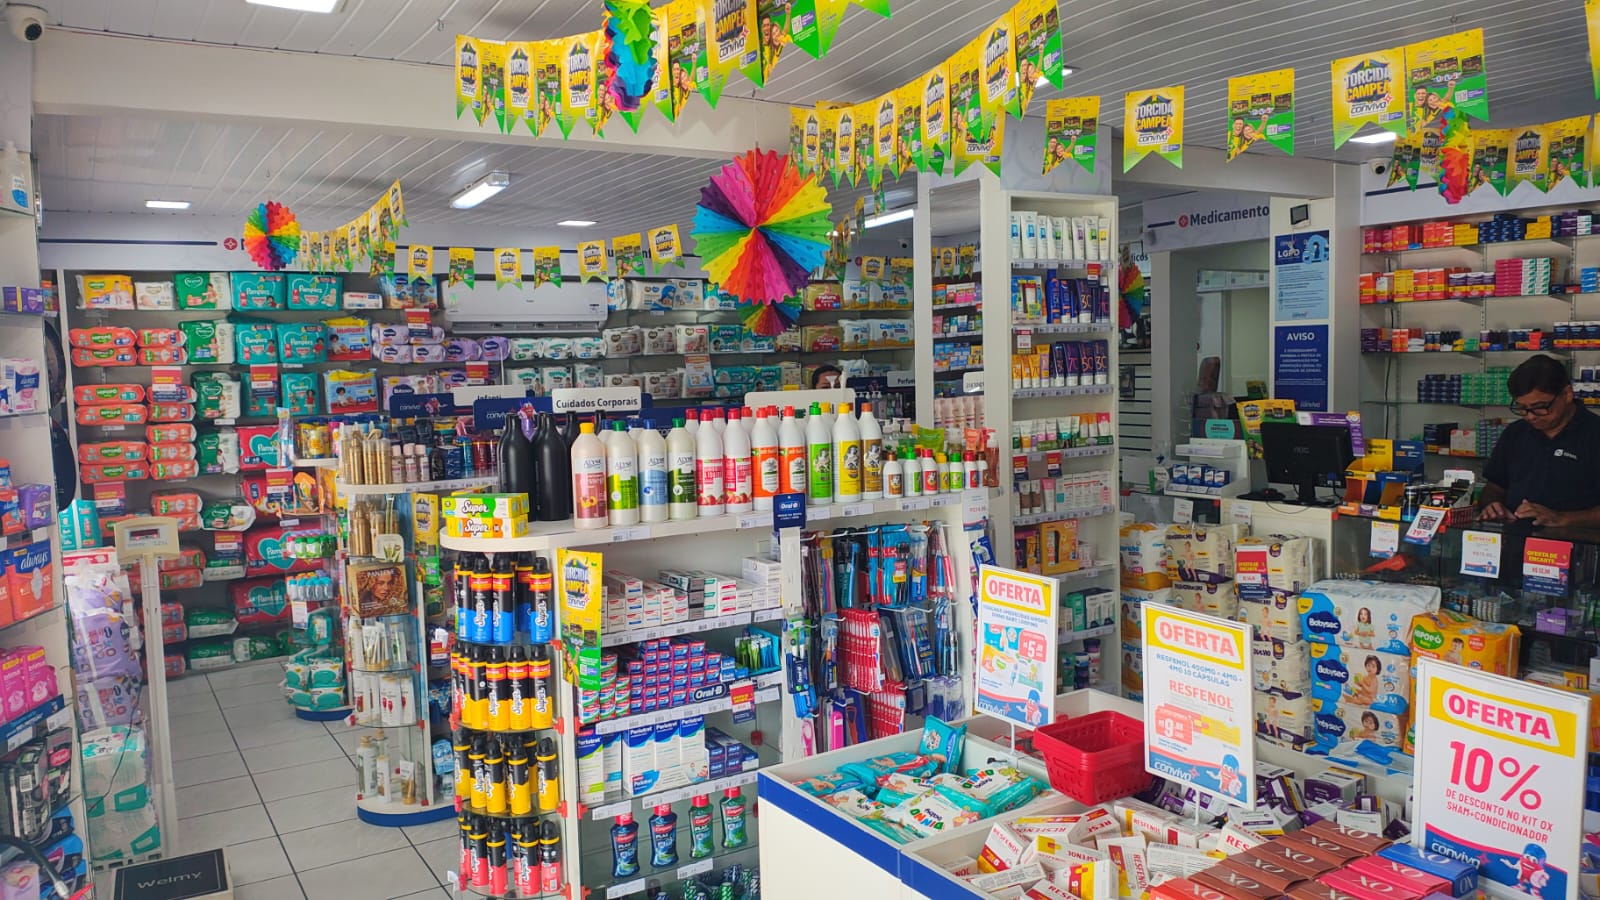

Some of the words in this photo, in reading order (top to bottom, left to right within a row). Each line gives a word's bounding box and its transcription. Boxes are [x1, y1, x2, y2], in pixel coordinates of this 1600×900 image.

[1344, 67, 1391, 89] TORCIDA
[1134, 102, 1173, 118] TORCIDA
[1287, 332, 1315, 341] AVISO
[556, 400, 596, 409] Cuidados
[597, 399, 638, 410] Corporais
[462, 501, 489, 515] Super
[465, 521, 490, 535] Super
[21, 551, 49, 570] always
[988, 579, 1041, 605] OFERTA
[474, 601, 487, 627] Super
[535, 601, 549, 627] Super
[1309, 618, 1339, 630] Babysec
[1028, 640, 1035, 658] 5
[1159, 621, 1235, 657] OFERTA
[1156, 653, 1190, 668] RESFENOL
[1222, 671, 1237, 682] 4MG
[1168, 664, 1183, 675] 4MG
[1318, 666, 1346, 678] Babysec
[488, 688, 499, 716] Super
[512, 689, 522, 715] Super
[536, 687, 547, 712] Super
[695, 686, 724, 699] Oral-B
[1169, 680, 1233, 710] RESFENOL
[1164, 718, 1174, 738] 9
[1448, 694, 1552, 740] OFERTA
[962, 769, 994, 789] DINNO
[1154, 760, 1192, 781] convivo
[1450, 741, 1542, 810] 10%
[910, 808, 944, 830] DINNO
[1446, 788, 1457, 798] DE
[1458, 792, 1504, 817] DESCONTO
[1507, 809, 1519, 820] NO
[1522, 814, 1537, 826] KIT
[1540, 820, 1553, 833] OX
[1447, 802, 1549, 844] SHAM+CONDICIONADOR
[1431, 842, 1481, 869] convivo
[137, 871, 202, 889] Welmy
